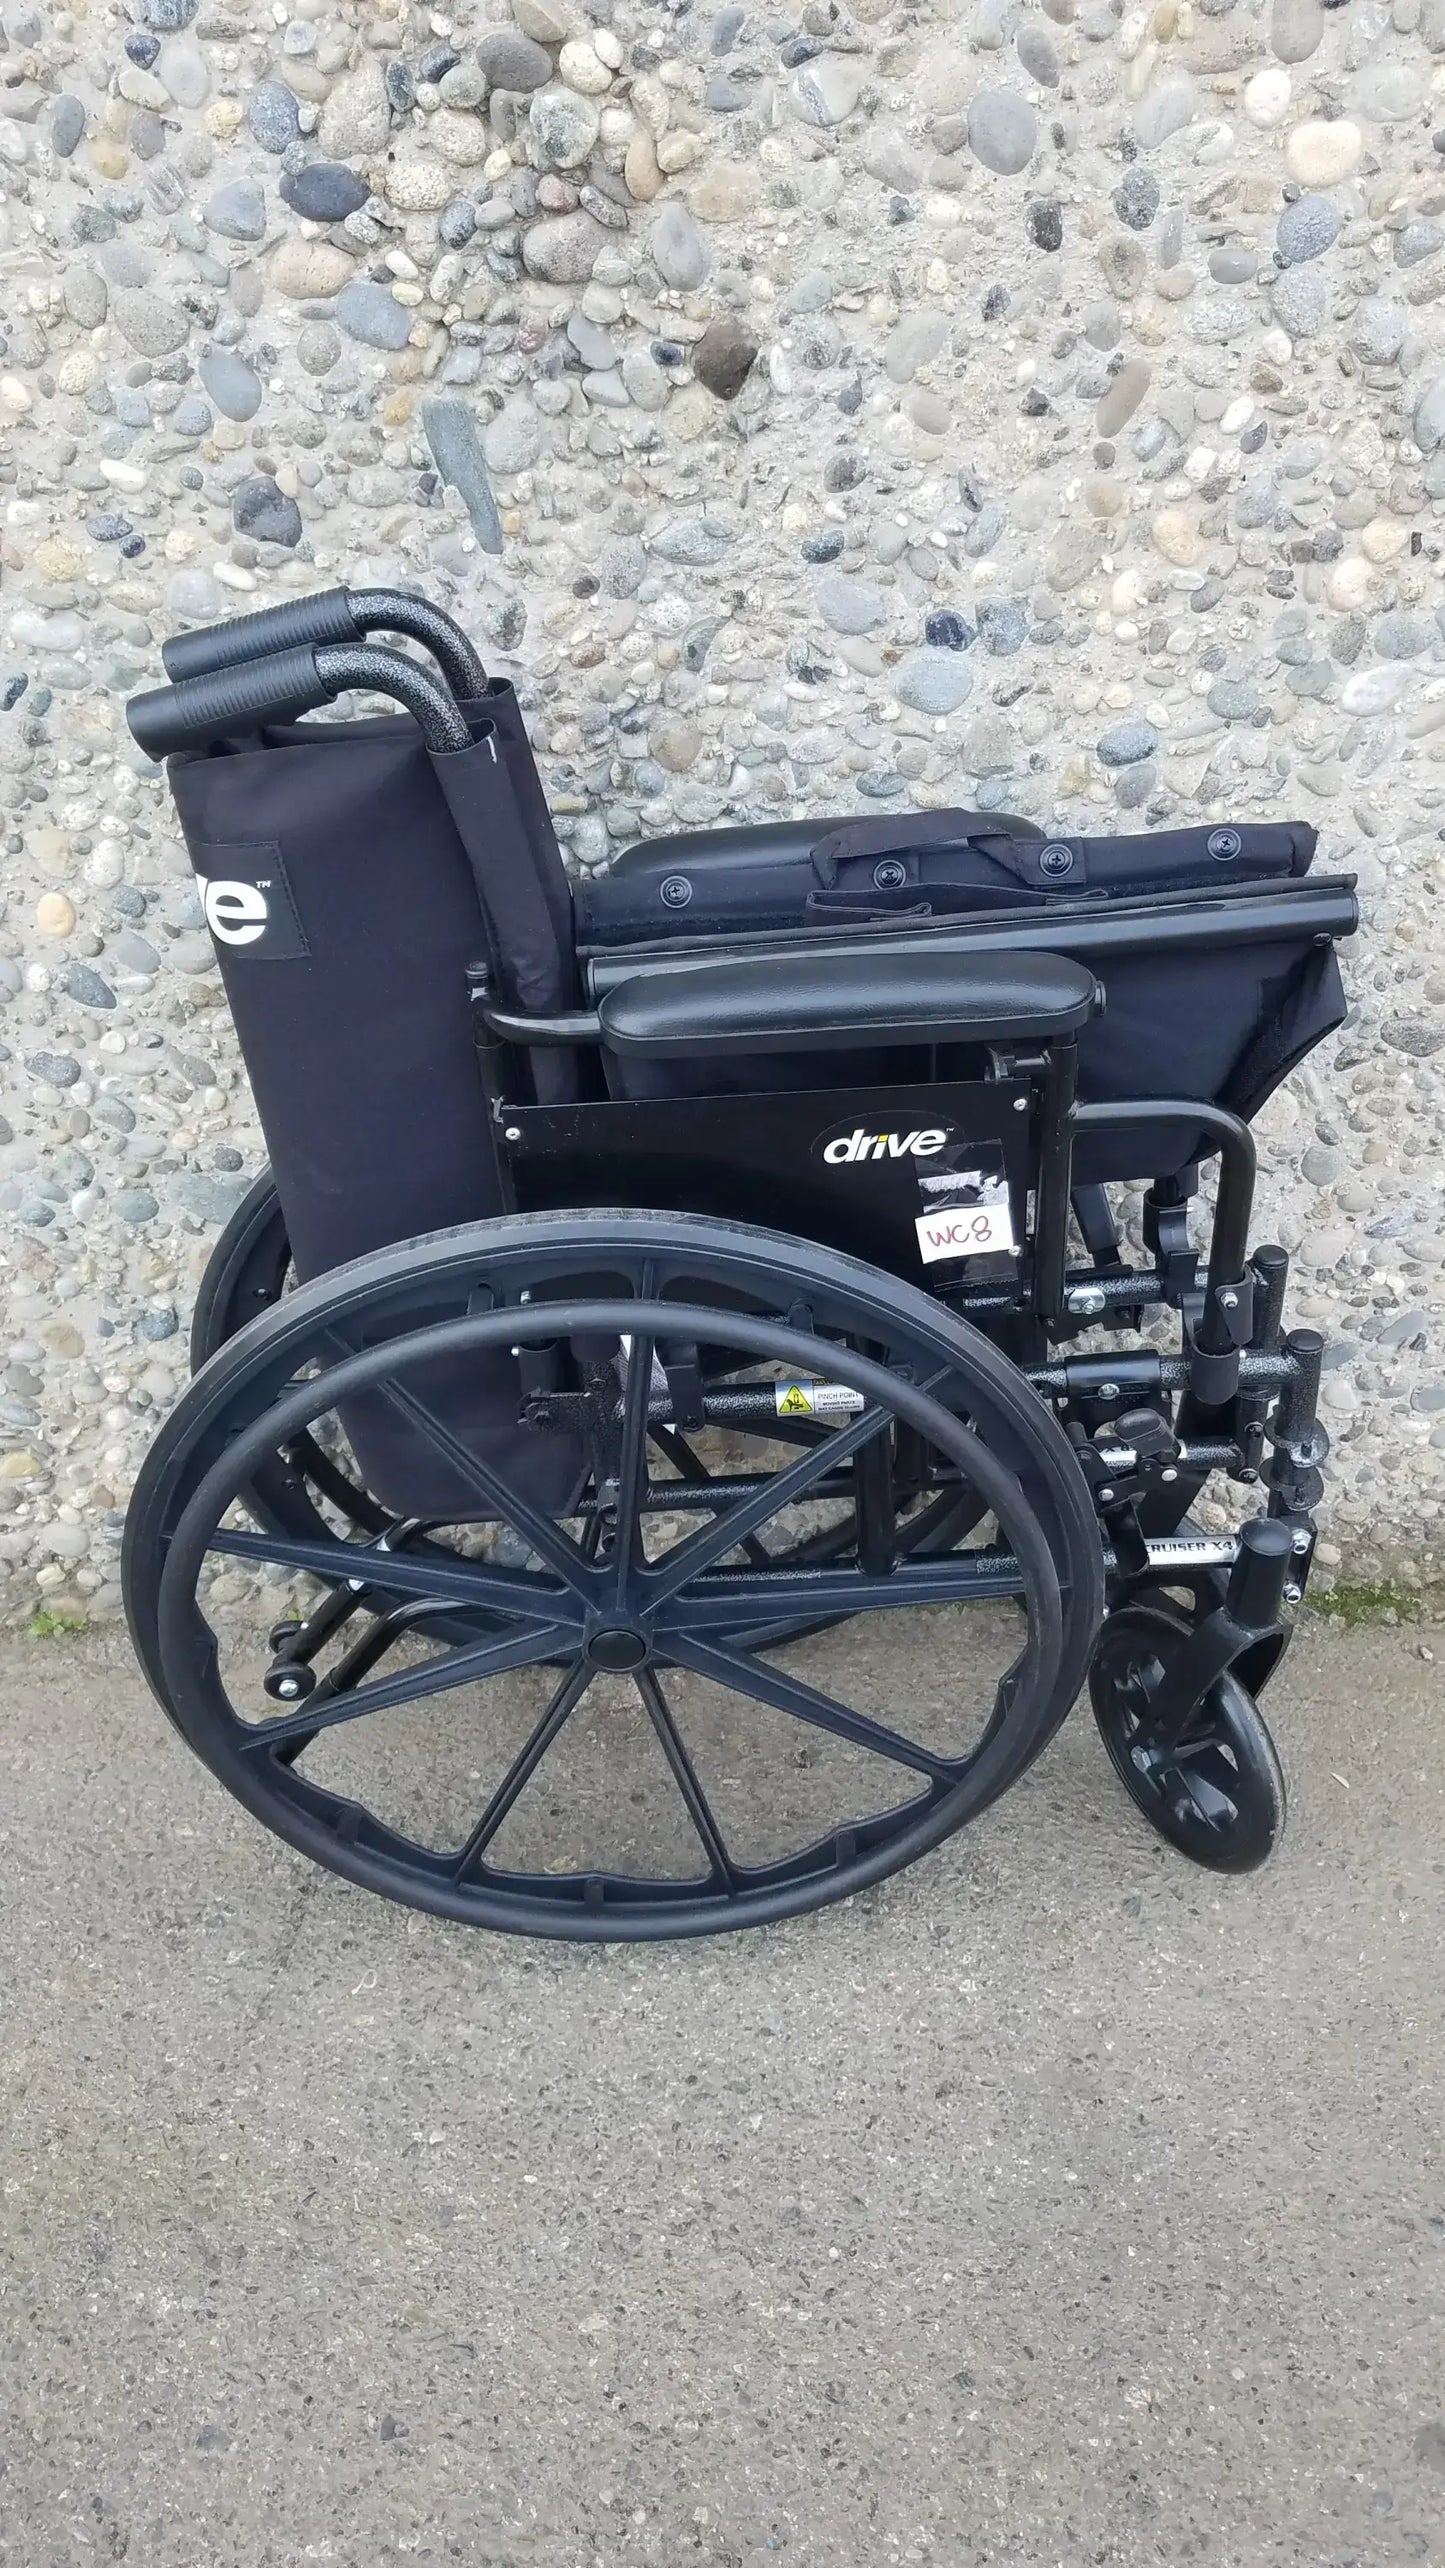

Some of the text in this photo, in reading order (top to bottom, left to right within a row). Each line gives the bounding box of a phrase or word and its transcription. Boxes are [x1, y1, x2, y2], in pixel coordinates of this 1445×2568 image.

[823, 1129, 946, 1164] drive
[818, 1392, 838, 1400] PINCH
[1210, 1541, 1233, 1551] X4
